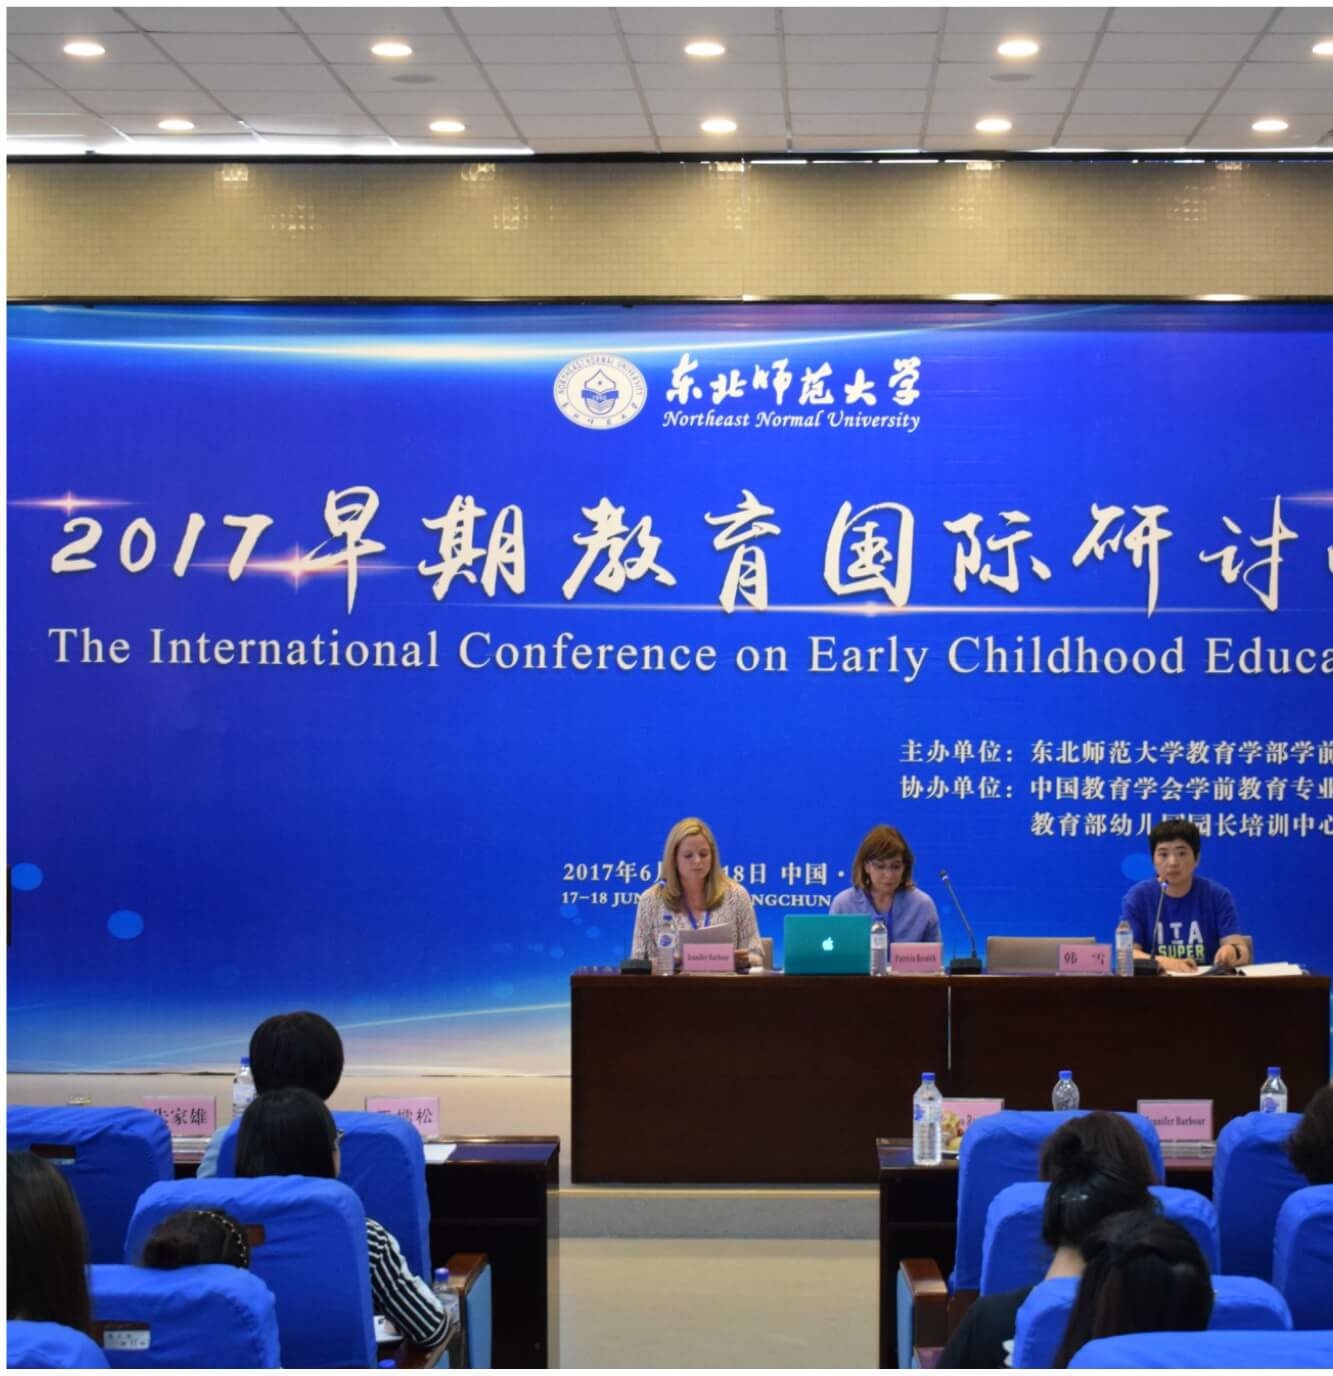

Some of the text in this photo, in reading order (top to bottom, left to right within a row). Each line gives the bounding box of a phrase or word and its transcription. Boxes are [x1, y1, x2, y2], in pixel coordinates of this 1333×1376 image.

[665, 352, 923, 406] 东北师范大学
[662, 409, 922, 434] Northeast Normal University
[48, 626, 131, 665] The
[148, 627, 442, 668] International
[458, 631, 718, 672] Conference
[735, 646, 788, 673] on
[808, 635, 929, 684] Early
[947, 635, 1186, 676] Childhood
